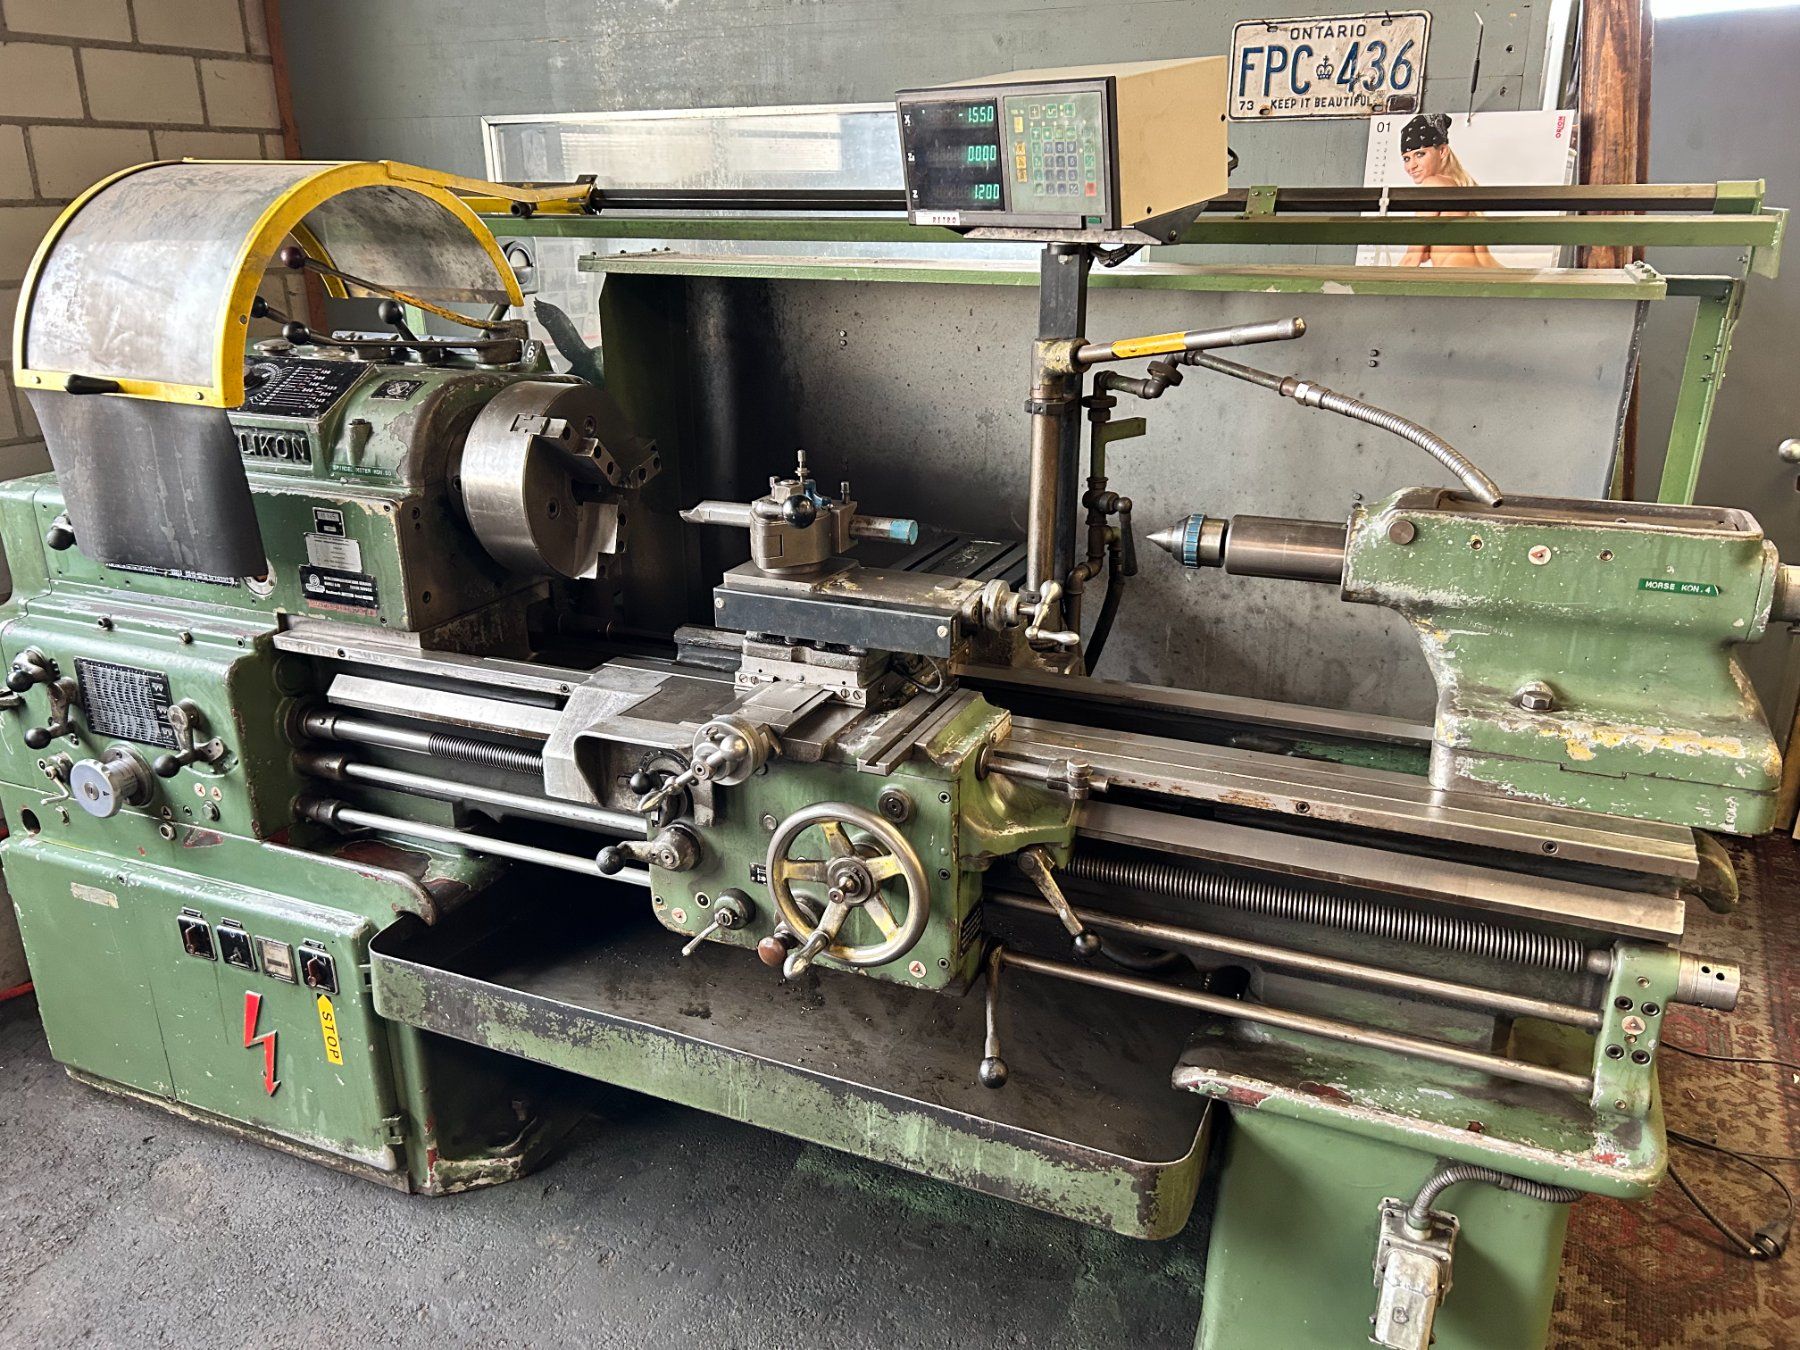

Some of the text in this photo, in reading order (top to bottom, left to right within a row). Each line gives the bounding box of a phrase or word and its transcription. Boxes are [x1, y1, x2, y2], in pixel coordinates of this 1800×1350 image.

[1290, 24, 1367, 41] ONTARIO
[1238, 39, 1415, 97] FPC 436
[1239, 101, 1255, 111] 73
[1270, 94, 1373, 110] KEEP IT BEAUTIFUL
[1377, 121, 1391, 133] 01
[1555, 115, 1563, 139] ORION
[239, 432, 311, 463] LIKON
[1645, 580, 1711, 594] MORSE KON.4
[322, 1011, 340, 1059] STOP
